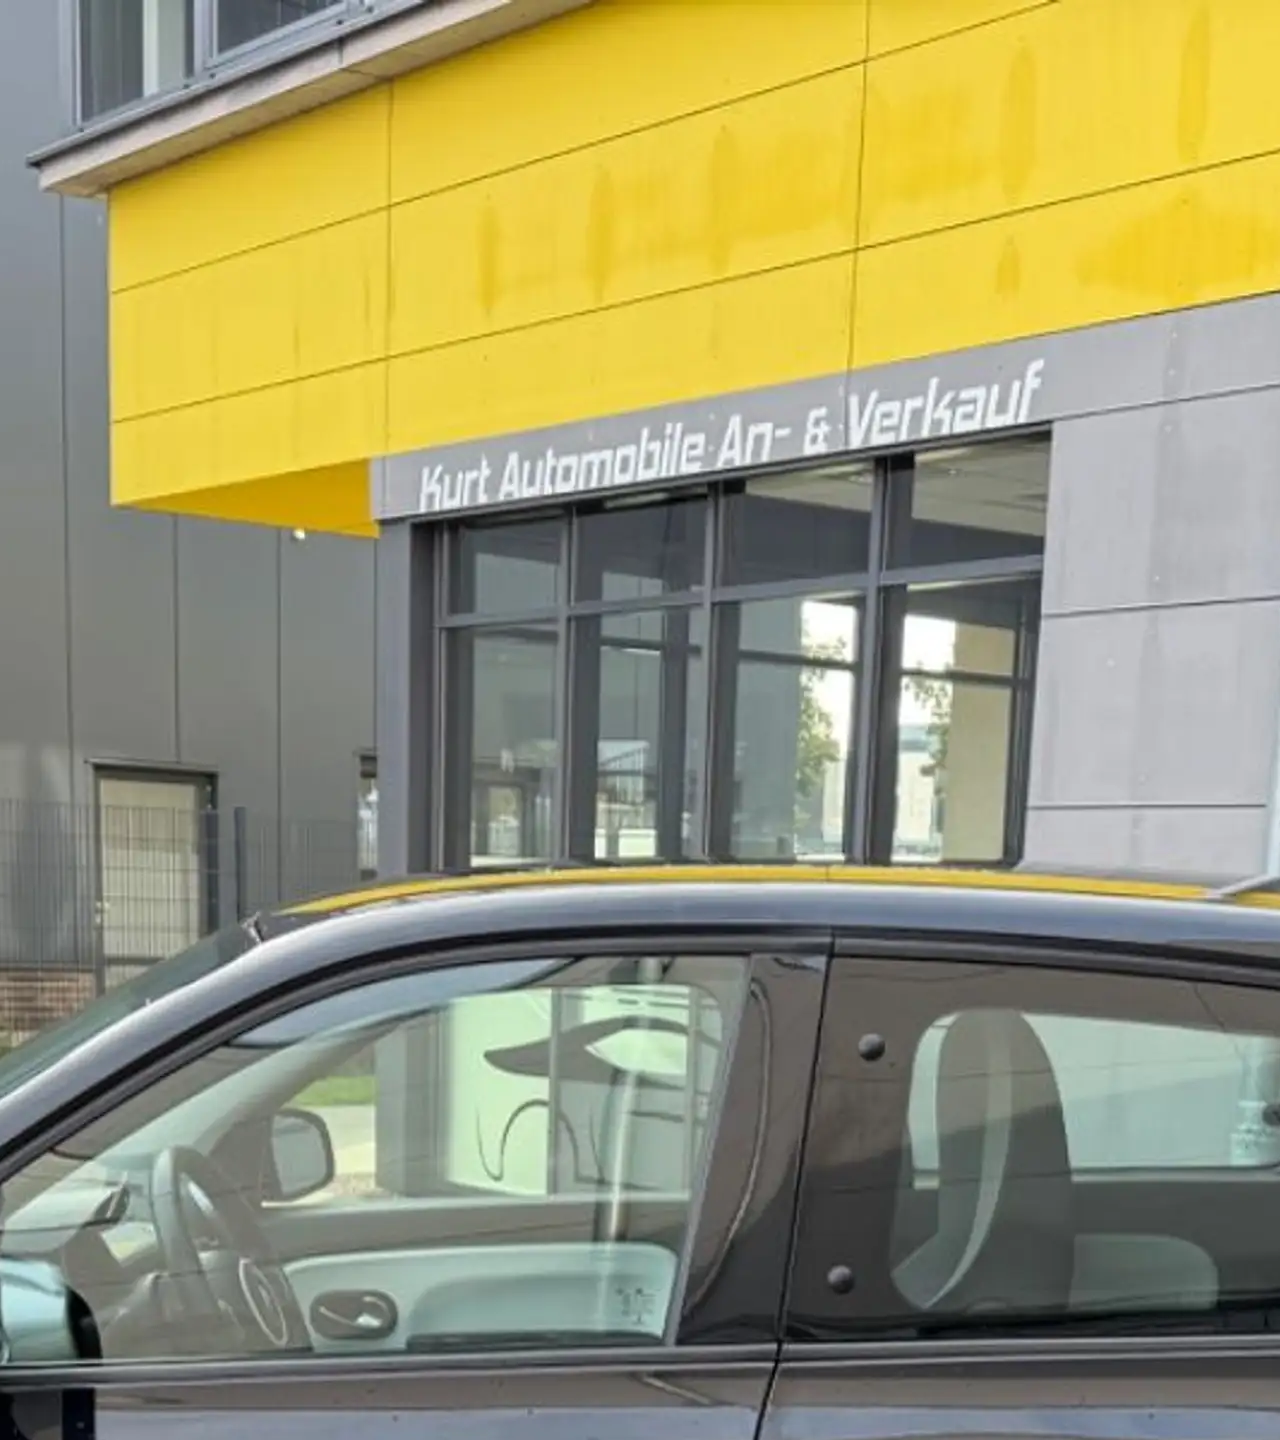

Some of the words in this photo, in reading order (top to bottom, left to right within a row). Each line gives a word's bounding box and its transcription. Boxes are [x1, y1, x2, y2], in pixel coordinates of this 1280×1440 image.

[419, 452, 492, 513] Kurt
[499, 422, 707, 502] Automobile
[716, 413, 792, 469] An-
[803, 405, 832, 455] &
[847, 358, 1046, 449] Verkauf
